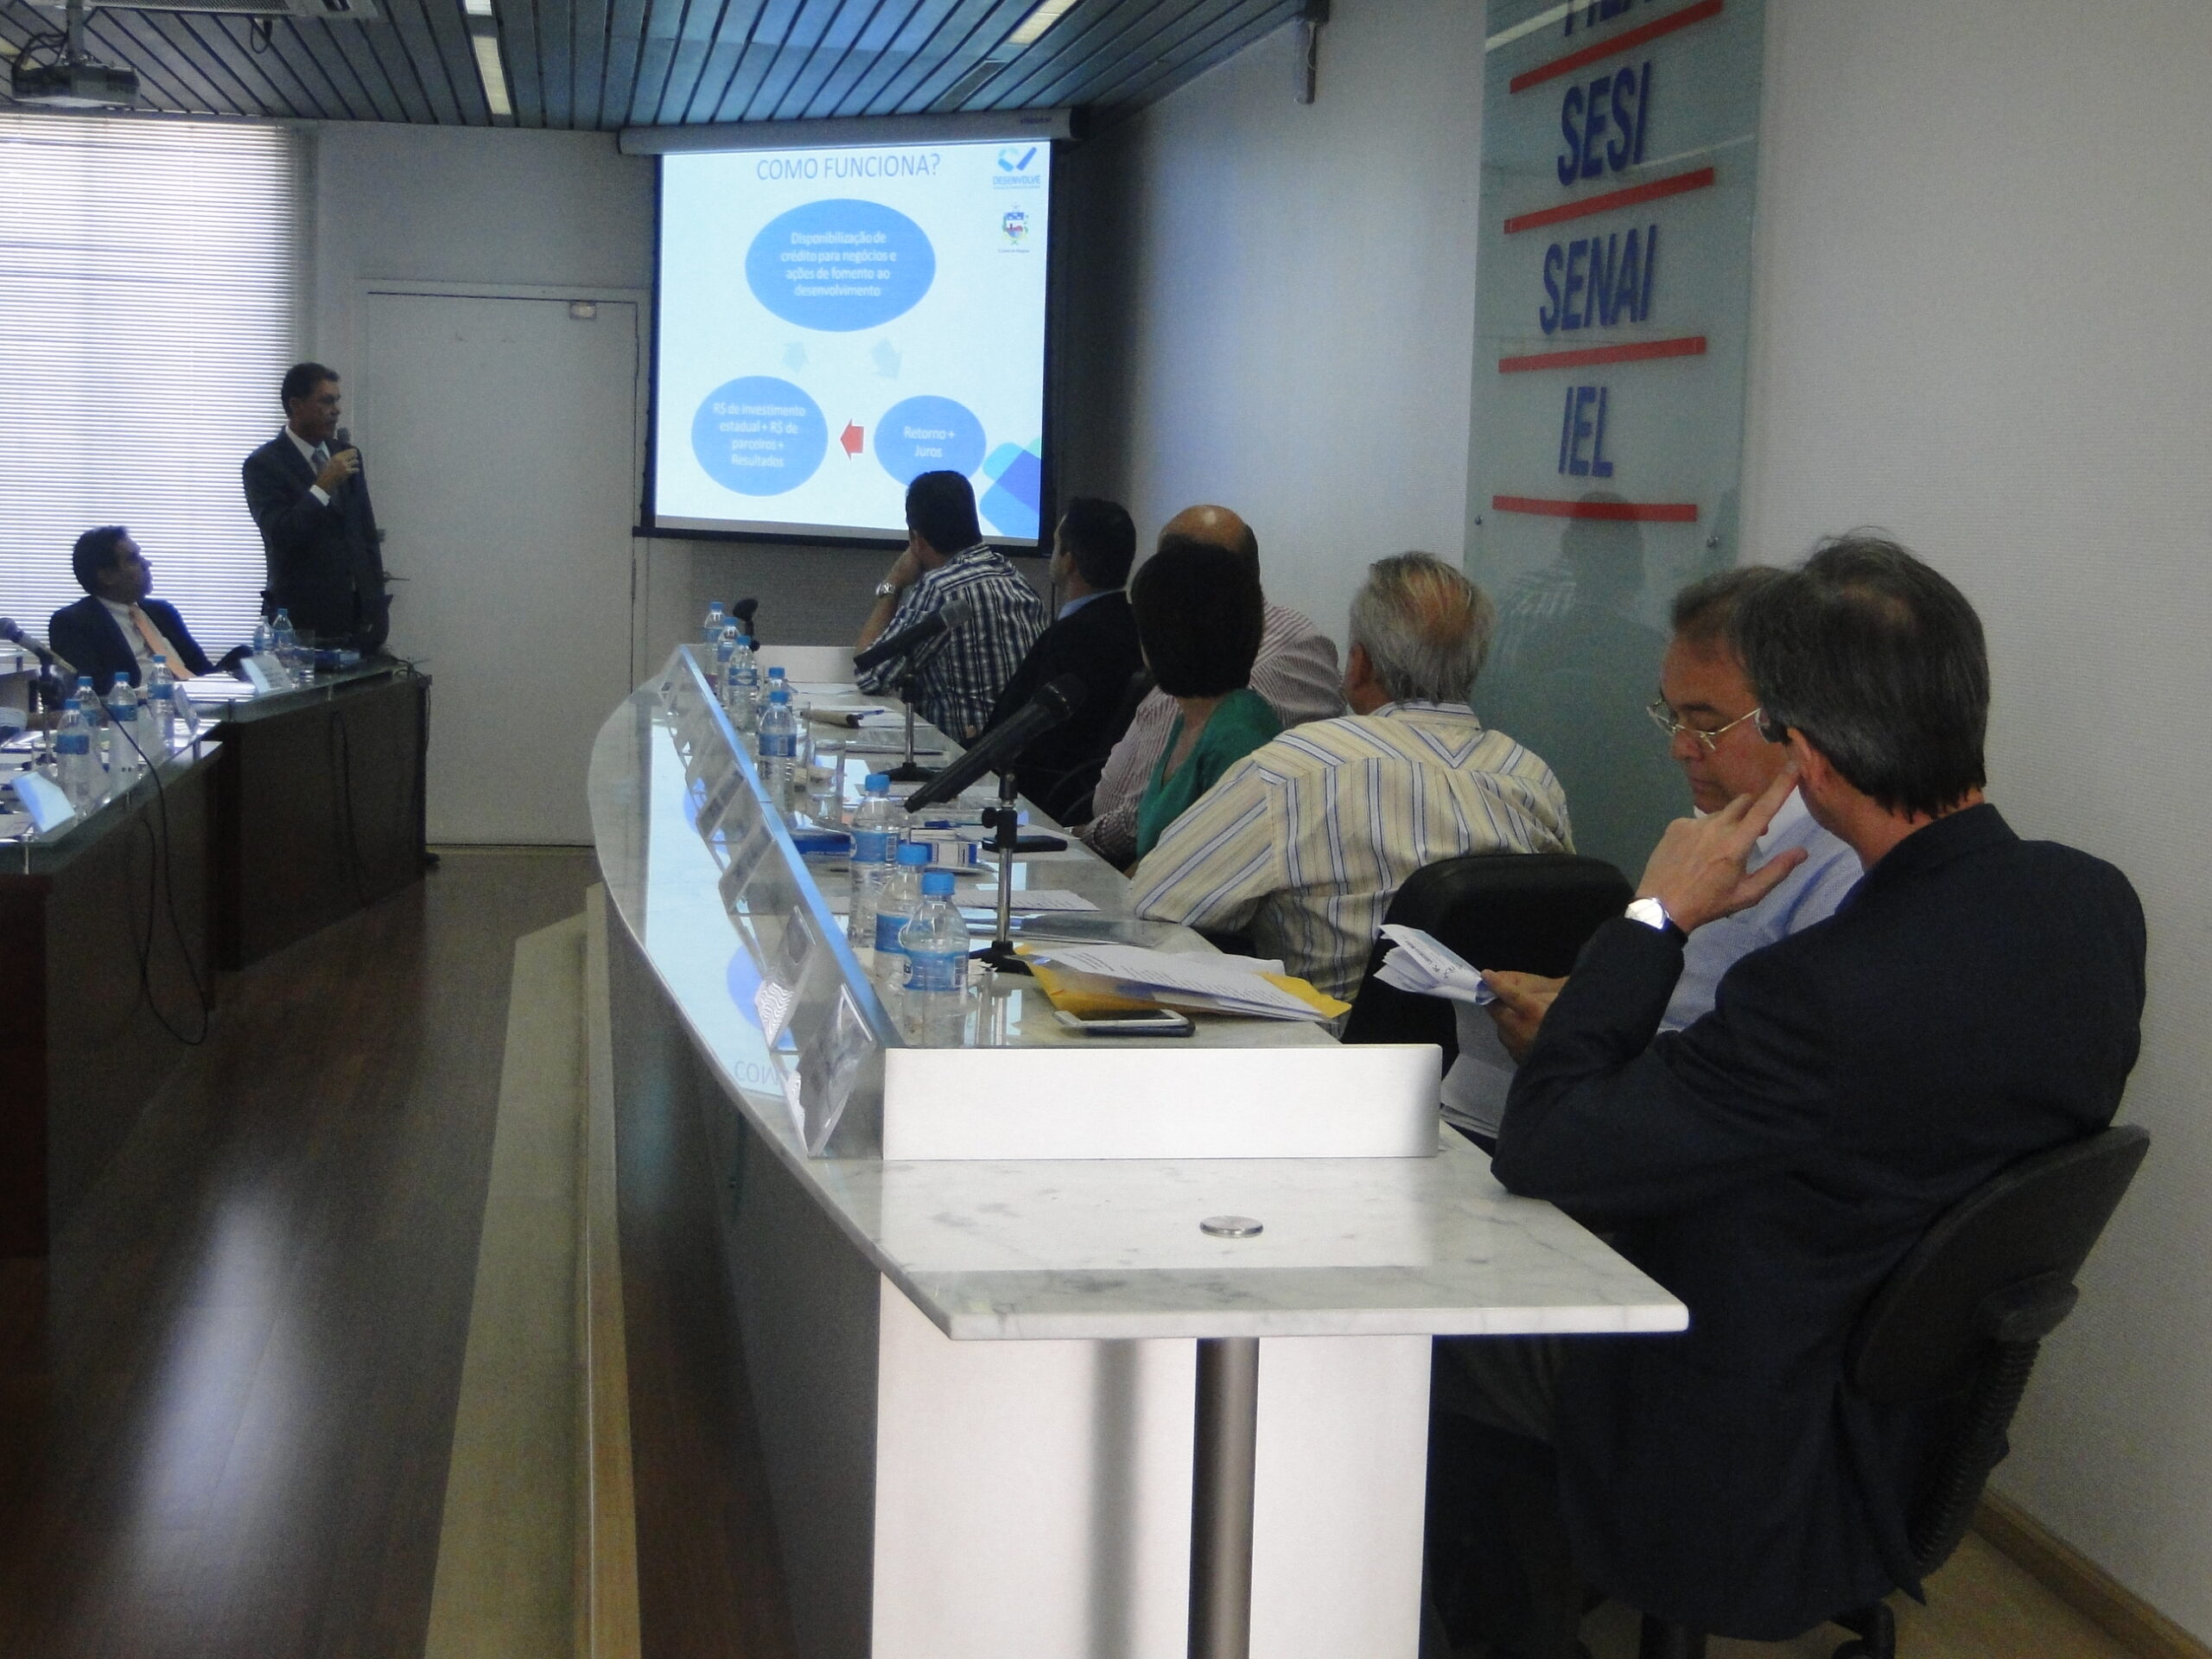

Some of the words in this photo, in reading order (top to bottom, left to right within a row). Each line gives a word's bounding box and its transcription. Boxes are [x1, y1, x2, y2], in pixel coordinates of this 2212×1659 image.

[1556, 60, 1651, 188] SESI
[756, 157, 818, 181] COMO
[823, 152, 941, 180] FUNCIONA?
[992, 175, 1041, 185] DESENVOLVE
[791, 230, 872, 246] Disponibilização
[873, 230, 887, 244] de
[780, 249, 817, 263] crédito
[817, 251, 841, 264] para
[842, 249, 888, 264] negócios
[889, 251, 897, 263] e
[786, 267, 815, 282] ações
[816, 267, 830, 280] de
[831, 266, 874, 280] fomento
[876, 269, 891, 280] ao
[1539, 224, 1658, 336] SENAI
[794, 284, 881, 297] desenvolvimento
[728, 403, 741, 415] de
[741, 404, 806, 417] investimento
[719, 420, 760, 433] estadual
[785, 422, 798, 434] de
[903, 425, 946, 441] Retorno
[1558, 385, 1614, 478] IEL
[732, 438, 777, 450] parceiros
[914, 445, 943, 459] Juros
[731, 454, 785, 467] Resultados
